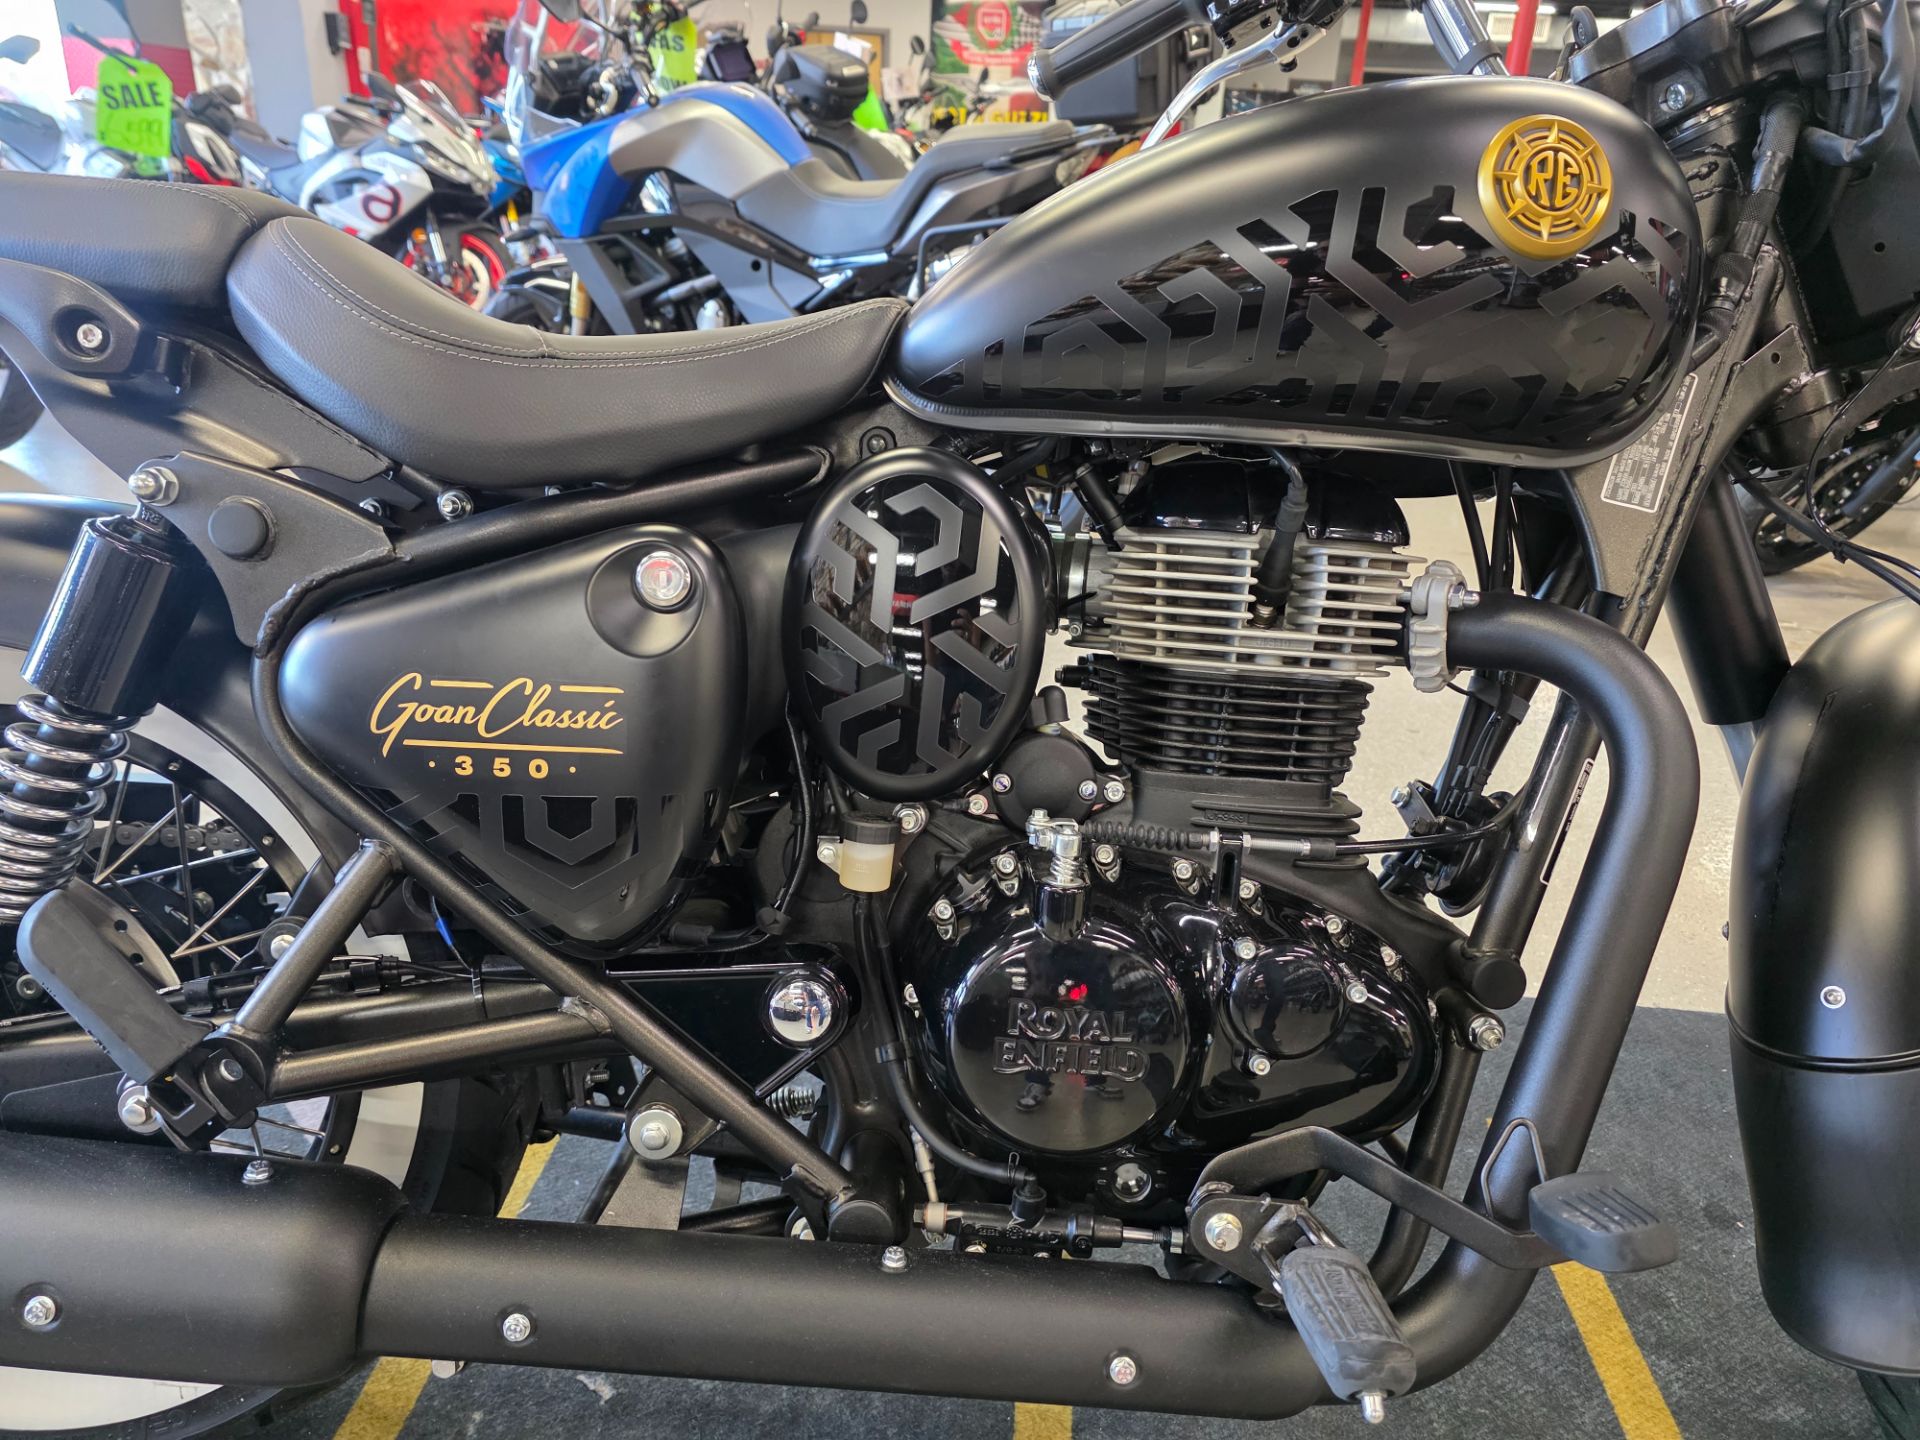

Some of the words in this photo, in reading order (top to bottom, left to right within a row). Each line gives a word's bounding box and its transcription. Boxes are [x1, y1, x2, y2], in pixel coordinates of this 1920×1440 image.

[102, 82, 163, 110] SALE
[369, 672, 481, 758] Goan
[477, 677, 625, 739] Classic
[454, 754, 549, 780] 350
[1008, 997, 1134, 1041] ROYAL
[992, 1036, 1151, 1083] ENFIELD
